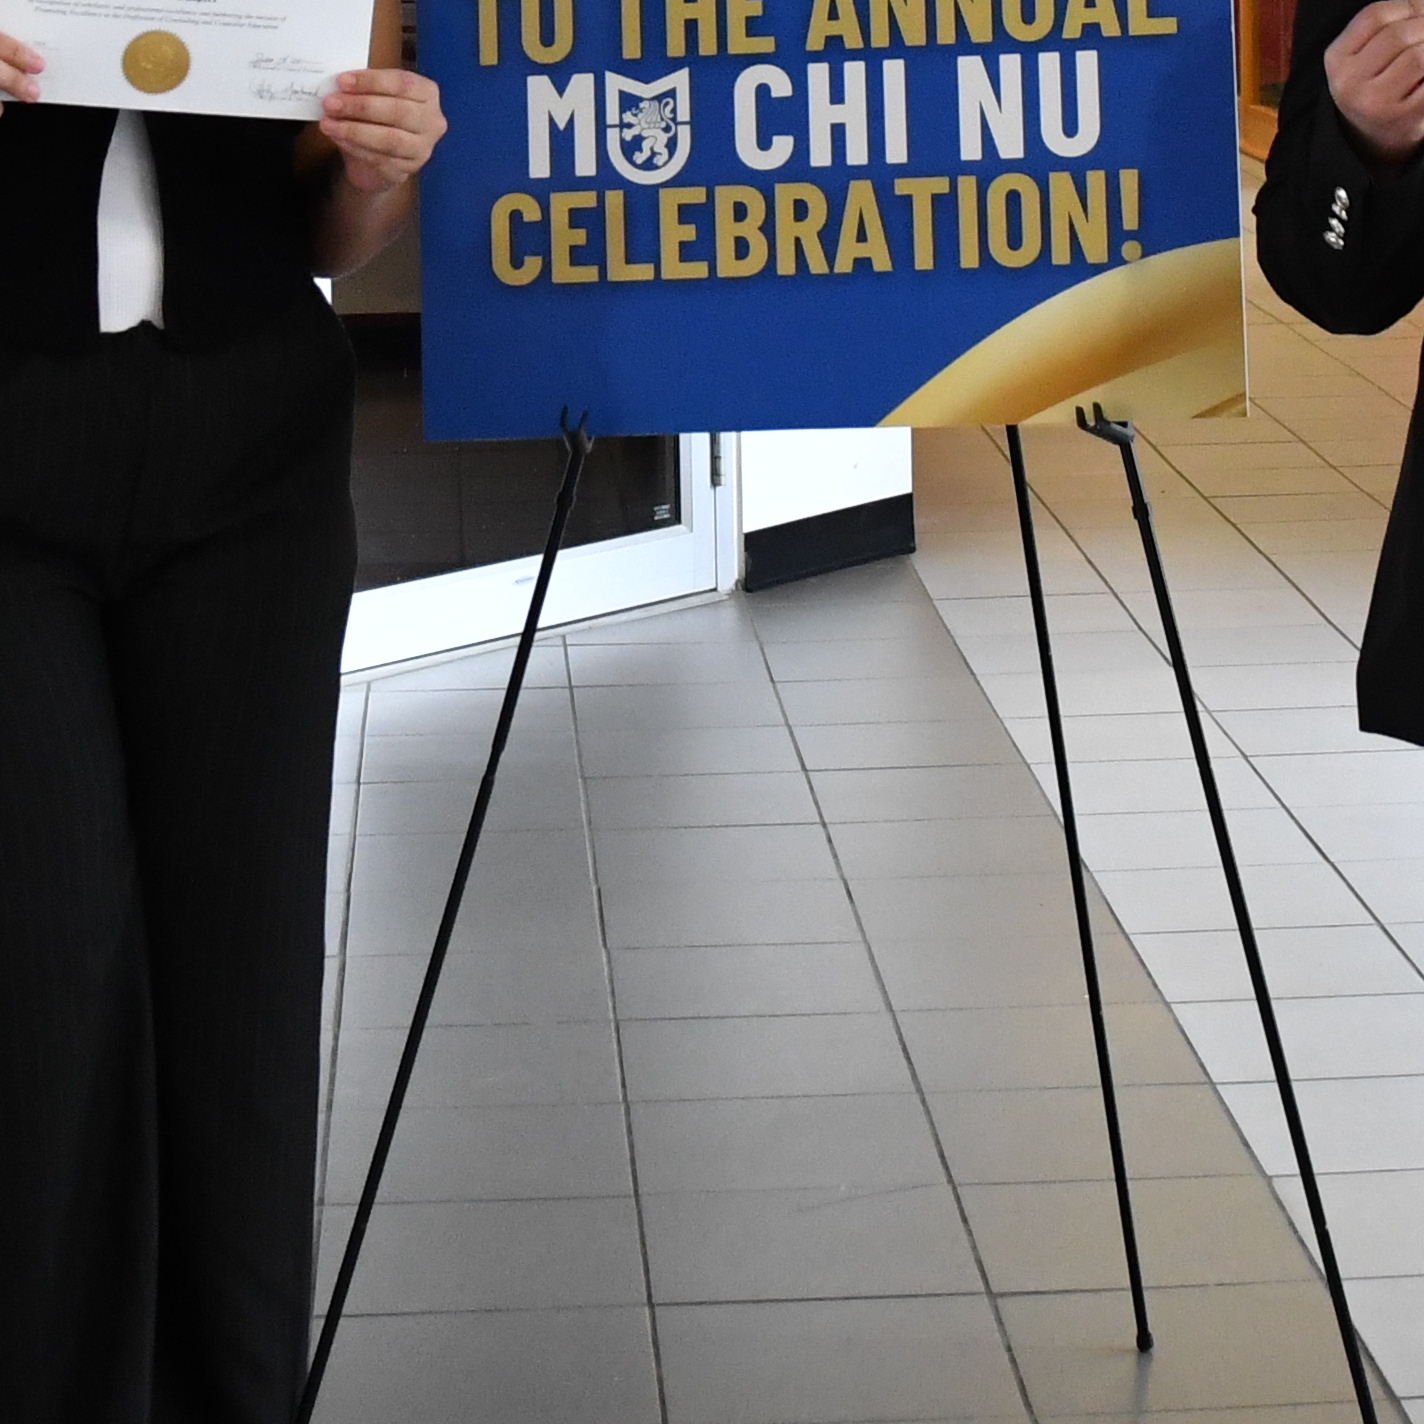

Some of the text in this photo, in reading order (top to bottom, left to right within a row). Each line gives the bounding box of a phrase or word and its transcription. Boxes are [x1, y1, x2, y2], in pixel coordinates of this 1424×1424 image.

[733, 57, 908, 171] CHI
[956, 49, 1101, 161] NU
[489, 168, 1143, 287] CELEBRATION!
